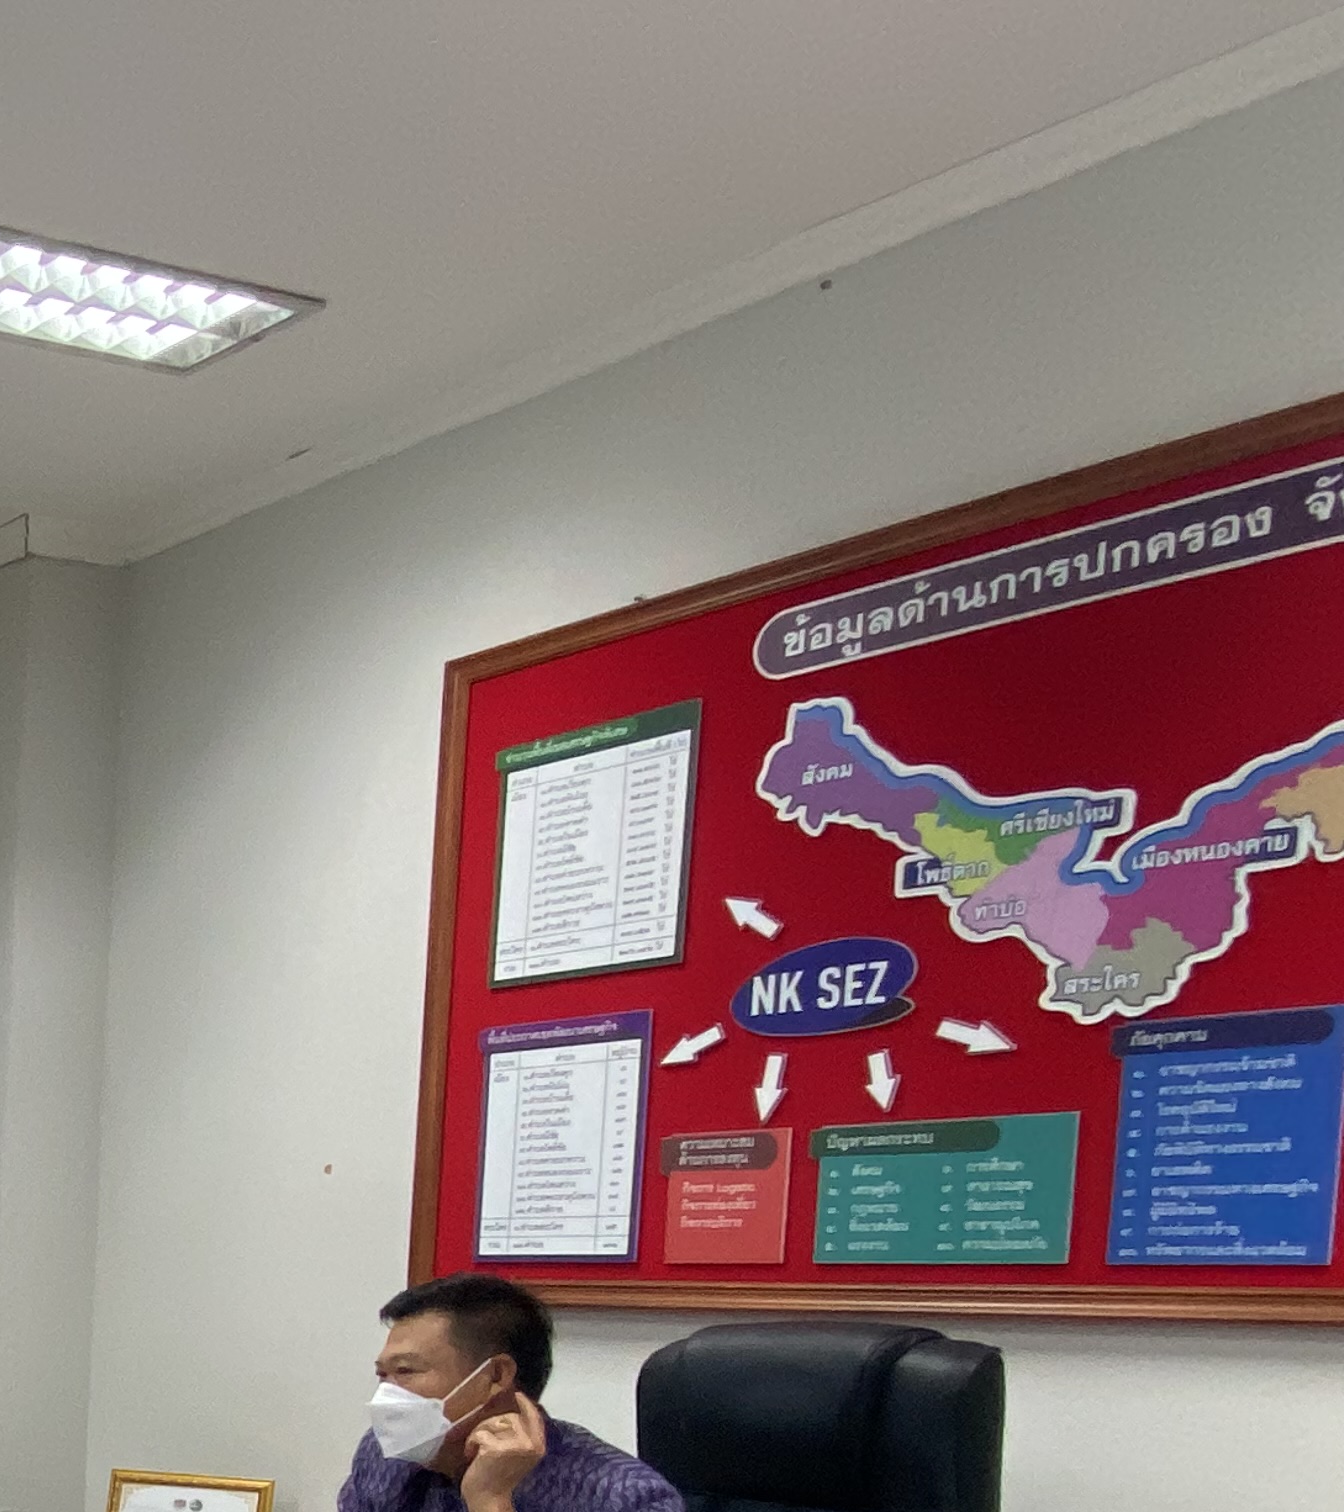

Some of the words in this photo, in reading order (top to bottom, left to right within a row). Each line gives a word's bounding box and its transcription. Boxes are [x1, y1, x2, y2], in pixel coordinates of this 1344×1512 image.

[783, 505, 1274, 658] ข้อมูลด้านการปกครอง
[801, 763, 853, 785] สังคม
[1000, 799, 1114, 837] ศรีเชียงใหม่
[1131, 833, 1290, 870] เมืองหนองคาย
[750, 970, 804, 1017] NK
[816, 960, 889, 1009] SEZ
